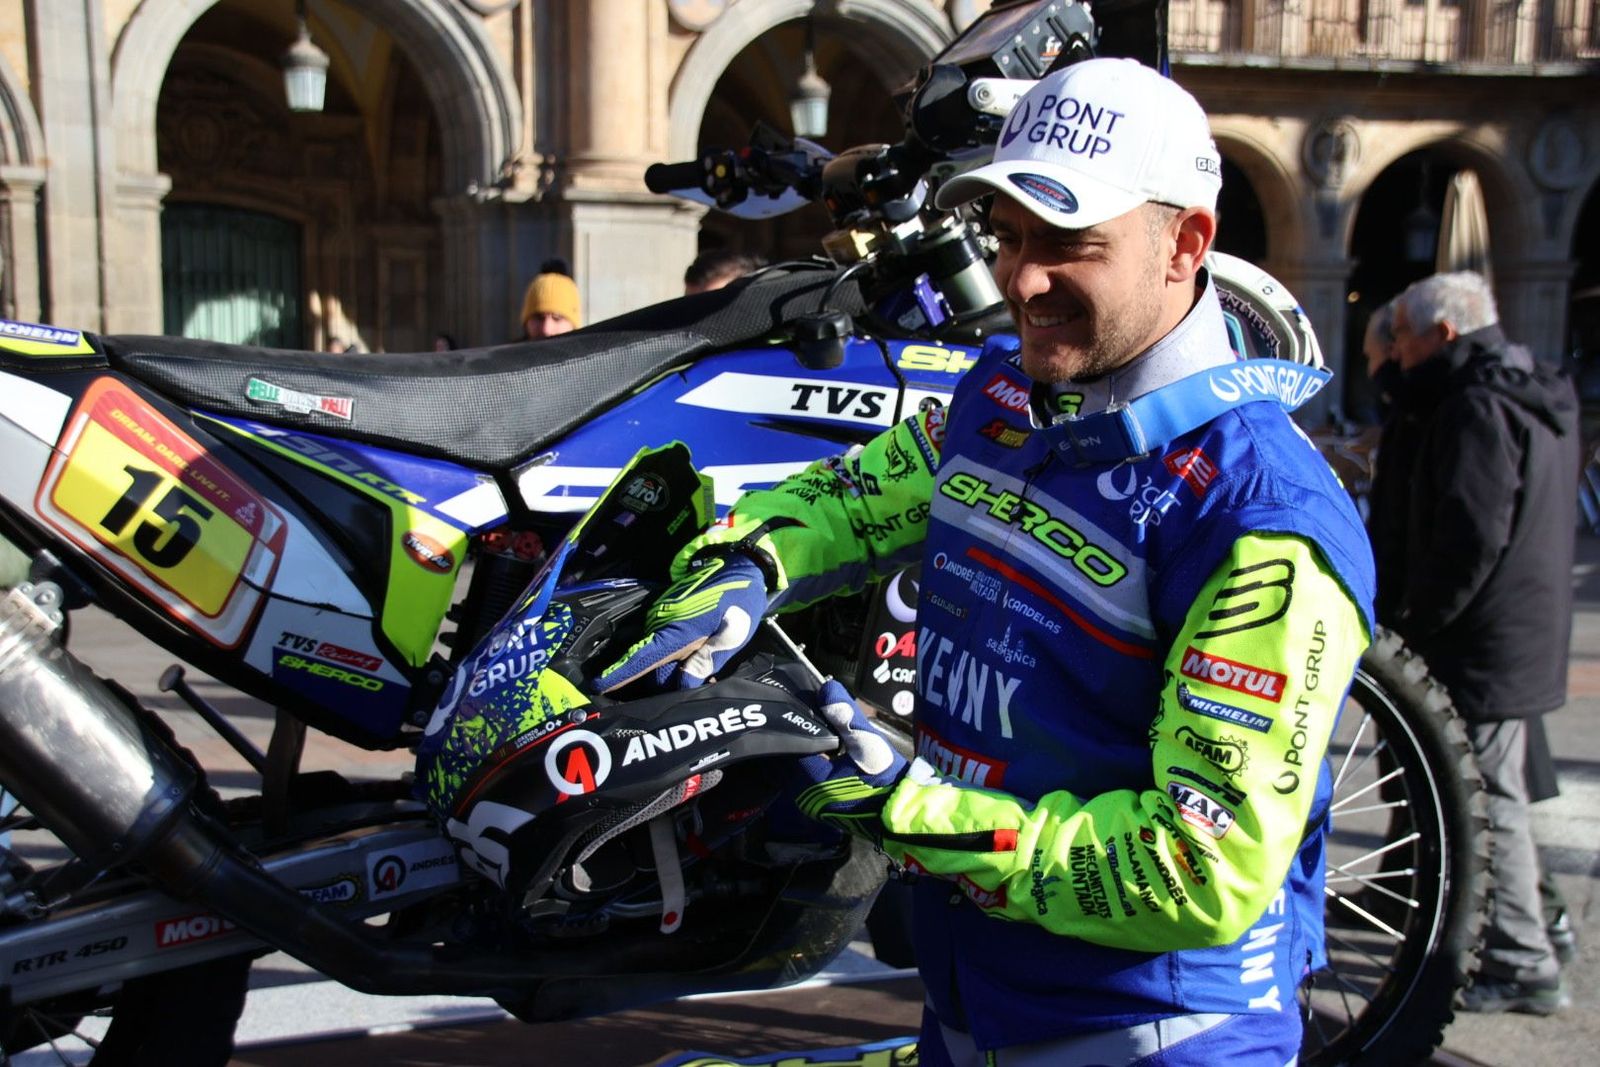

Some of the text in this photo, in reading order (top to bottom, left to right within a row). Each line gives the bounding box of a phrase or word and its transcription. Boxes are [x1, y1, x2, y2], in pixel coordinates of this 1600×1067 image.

[1037, 95, 1124, 134] PONT
[1027, 121, 1111, 159] GRUP
[791, 384, 885, 419] TVS
[1231, 365, 1323, 407] PONT GRUP
[100, 465, 214, 568] 15
[940, 471, 1128, 587] SHERCO
[408, 536, 434, 558] Twin
[1007, 598, 1062, 635] CANDELAS
[279, 632, 317, 653] TVS
[560, 617, 591, 655] AIROH
[279, 655, 384, 692] SHERCO
[469, 649, 547, 697] GRUP
[1183, 654, 1278, 698] MOTUL
[1283, 620, 1327, 766] PONT GRUP
[782, 711, 821, 736] AIROH
[1190, 698, 1269, 728] MICHELIN
[621, 703, 768, 767] ANDRÉS
[1170, 785, 1229, 830] MAC
[12, 936, 128, 974] RTR 450
